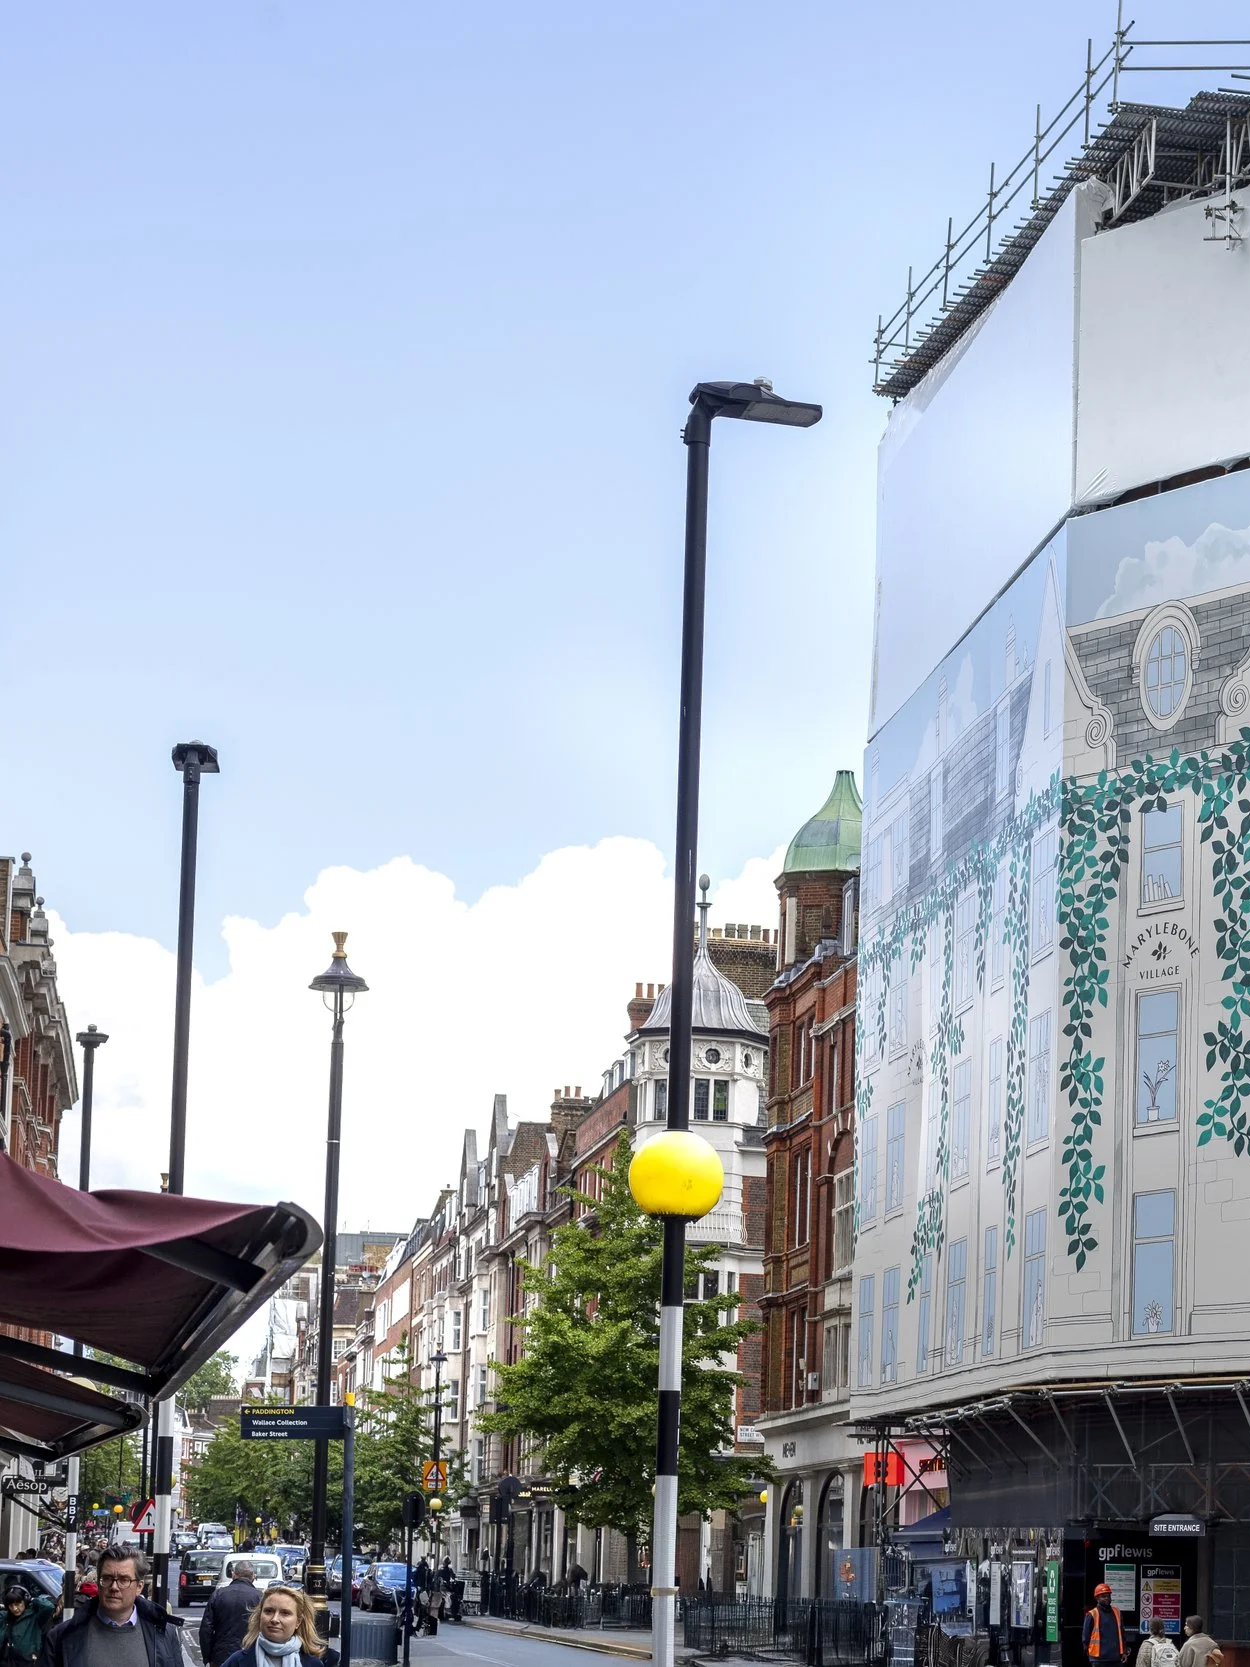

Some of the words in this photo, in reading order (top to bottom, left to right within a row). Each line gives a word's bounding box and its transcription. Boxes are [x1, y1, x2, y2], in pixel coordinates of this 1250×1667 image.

[1122, 922, 1200, 969] MARYLEBONE
[1139, 965, 1180, 980] VILLAGE
[1153, 1524, 1167, 1532] SITE
[1168, 1524, 1200, 1532] ENTRANCE
[1098, 1544, 1153, 1561] gpflewis
